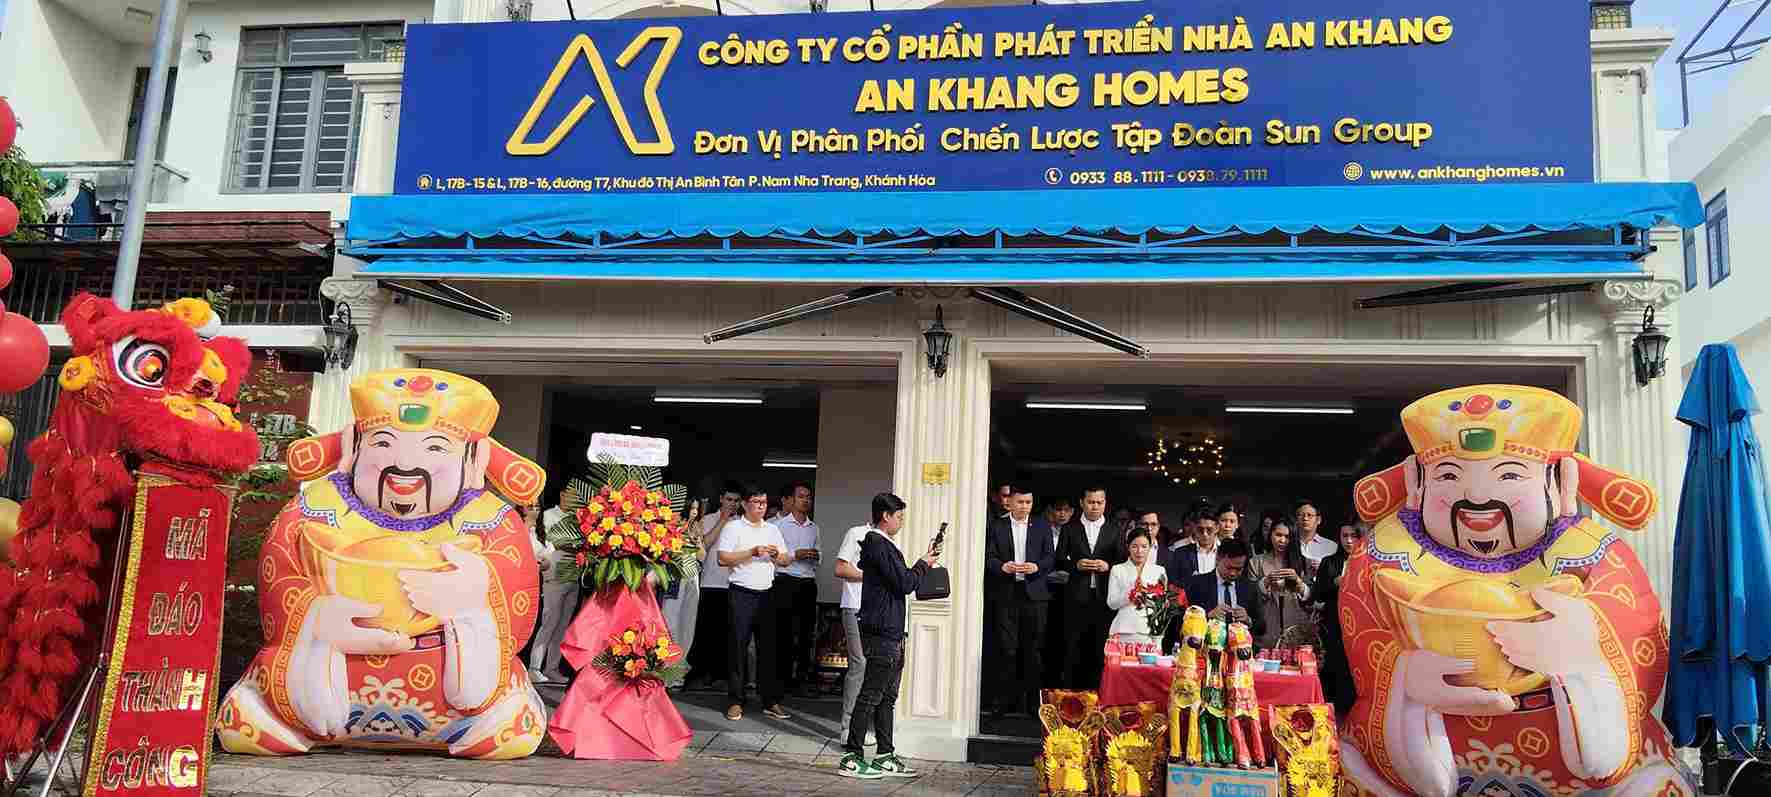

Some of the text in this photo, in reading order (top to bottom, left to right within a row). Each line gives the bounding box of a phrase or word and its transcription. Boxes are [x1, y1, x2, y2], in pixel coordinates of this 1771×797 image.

[698, 14, 1454, 65] CÔNG TY CỔ PHẦN PHÁT TRIỂN NHÀ AN KHANG
[855, 67, 1250, 113] AN KHANG HOMES
[693, 117, 1434, 159] Đơn Vị Phân Phối Chiến Lược Tập Đoàn Sun Group
[613, 176, 637, 189] Khu
[675, 176, 693, 188] An
[793, 174, 819, 187] Nha
[865, 173, 906, 186] Khánh
[1070, 171, 1106, 185] 0933
[165, 508, 212, 561] MÃ
[147, 581, 204, 637] ĐÁO
[121, 656, 208, 713] THÀNH
[102, 736, 200, 791] CÔNG
